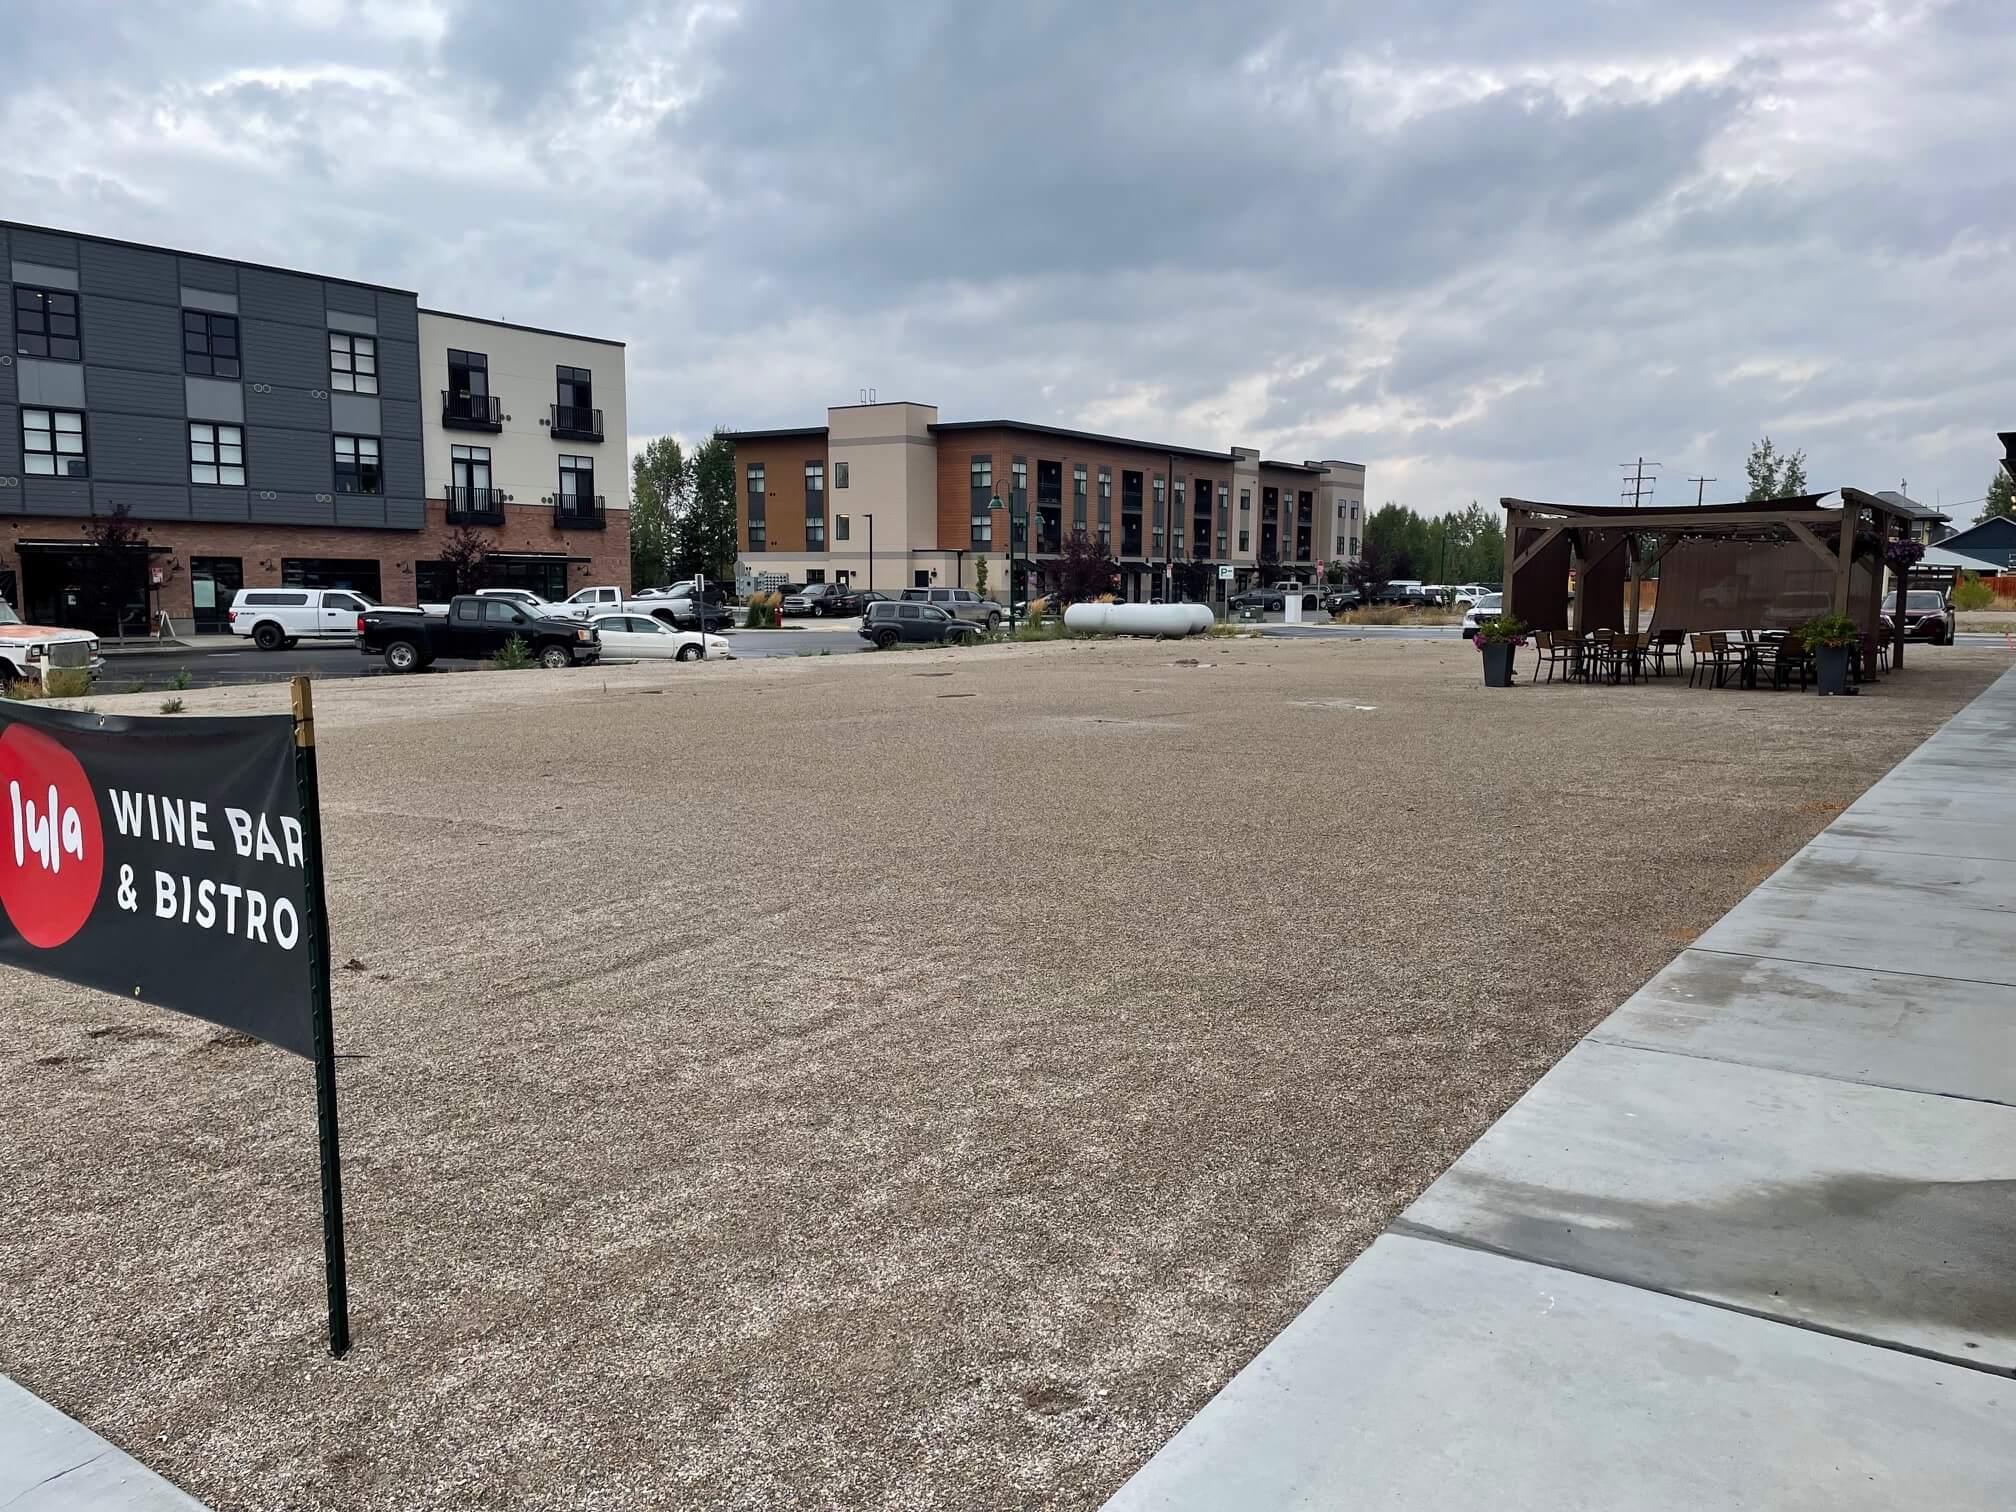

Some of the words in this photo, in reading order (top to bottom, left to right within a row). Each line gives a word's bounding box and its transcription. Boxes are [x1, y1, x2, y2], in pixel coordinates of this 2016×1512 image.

[10, 780, 83, 874] lula
[109, 788, 215, 851] WINE
[225, 807, 304, 869] BAR
[117, 863, 138, 912] &
[155, 870, 299, 950] BISTRO
